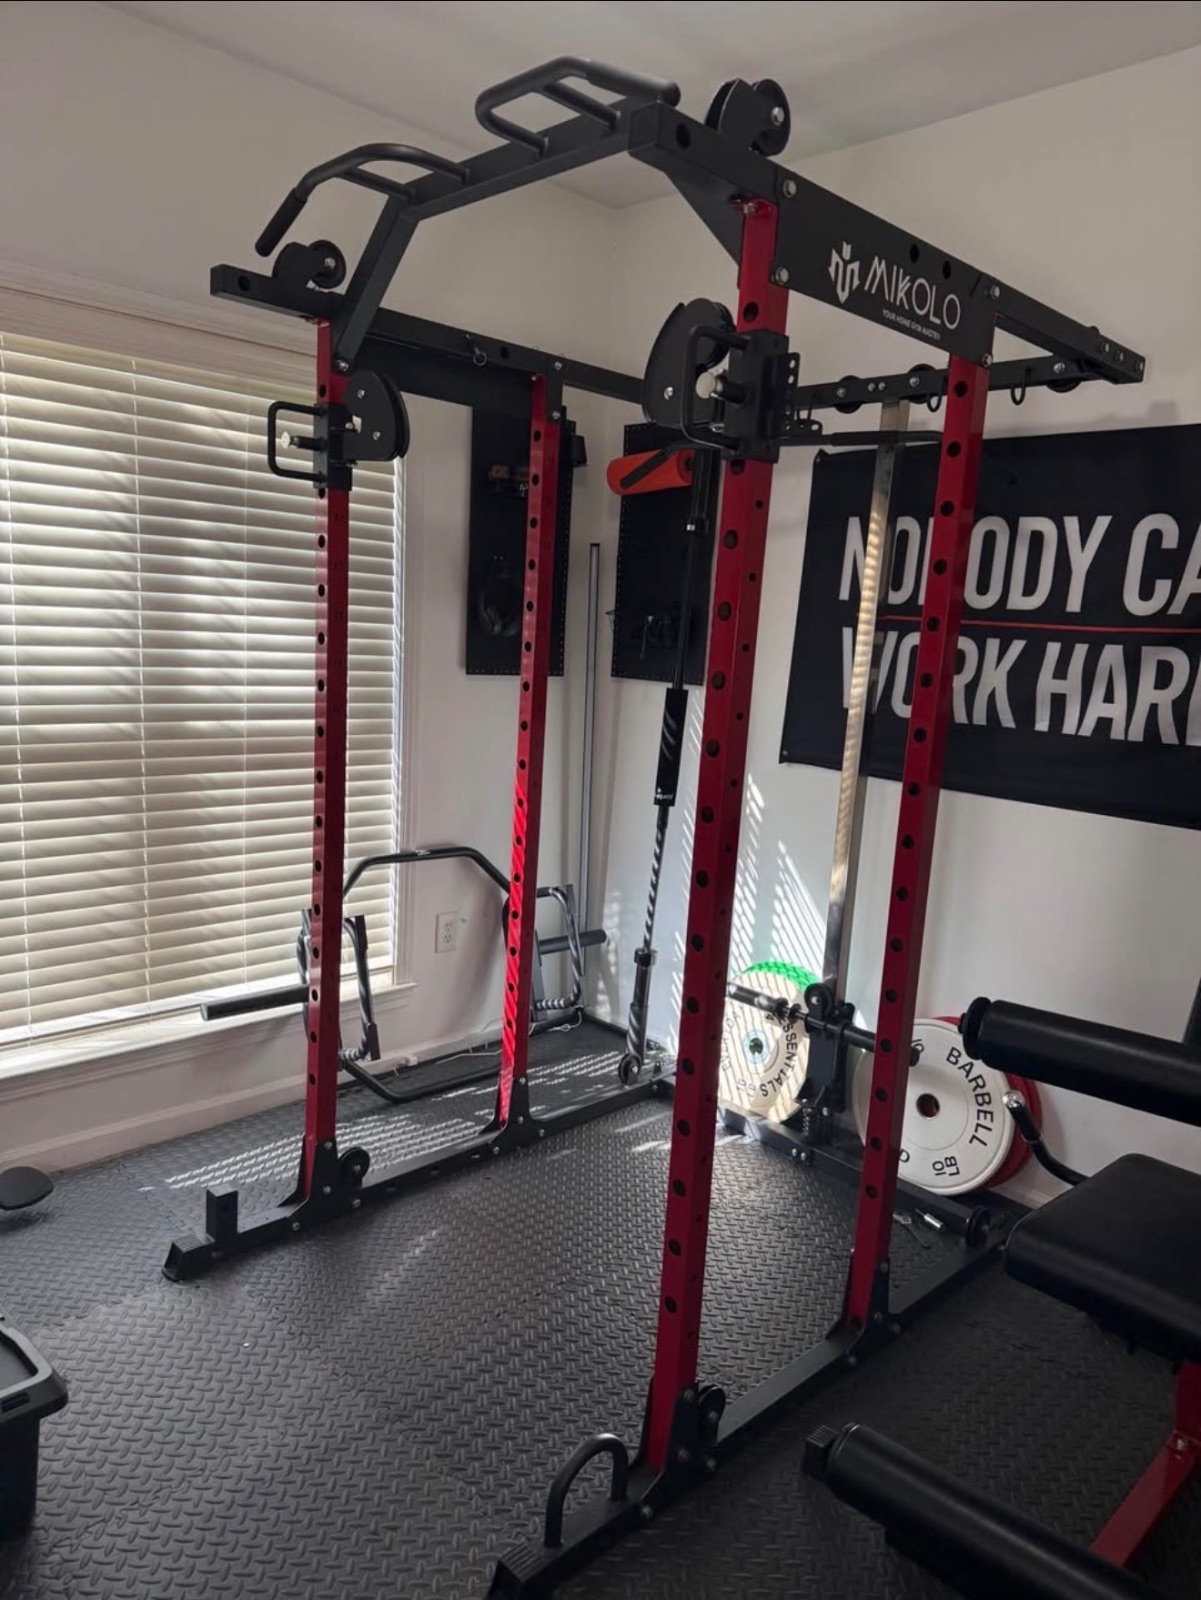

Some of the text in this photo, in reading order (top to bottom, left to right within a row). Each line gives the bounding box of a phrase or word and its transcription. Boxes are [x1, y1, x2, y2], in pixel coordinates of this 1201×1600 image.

[864, 256, 961, 330] MIKOLO
[882, 309, 896, 321] YOUR
[839, 515, 1112, 613] NOODY
[1034, 641, 1201, 747] HAR
[946, 1046, 994, 1148] BARBELL
[932, 1160, 946, 1176] 10
[944, 1156, 960, 1177] LB
